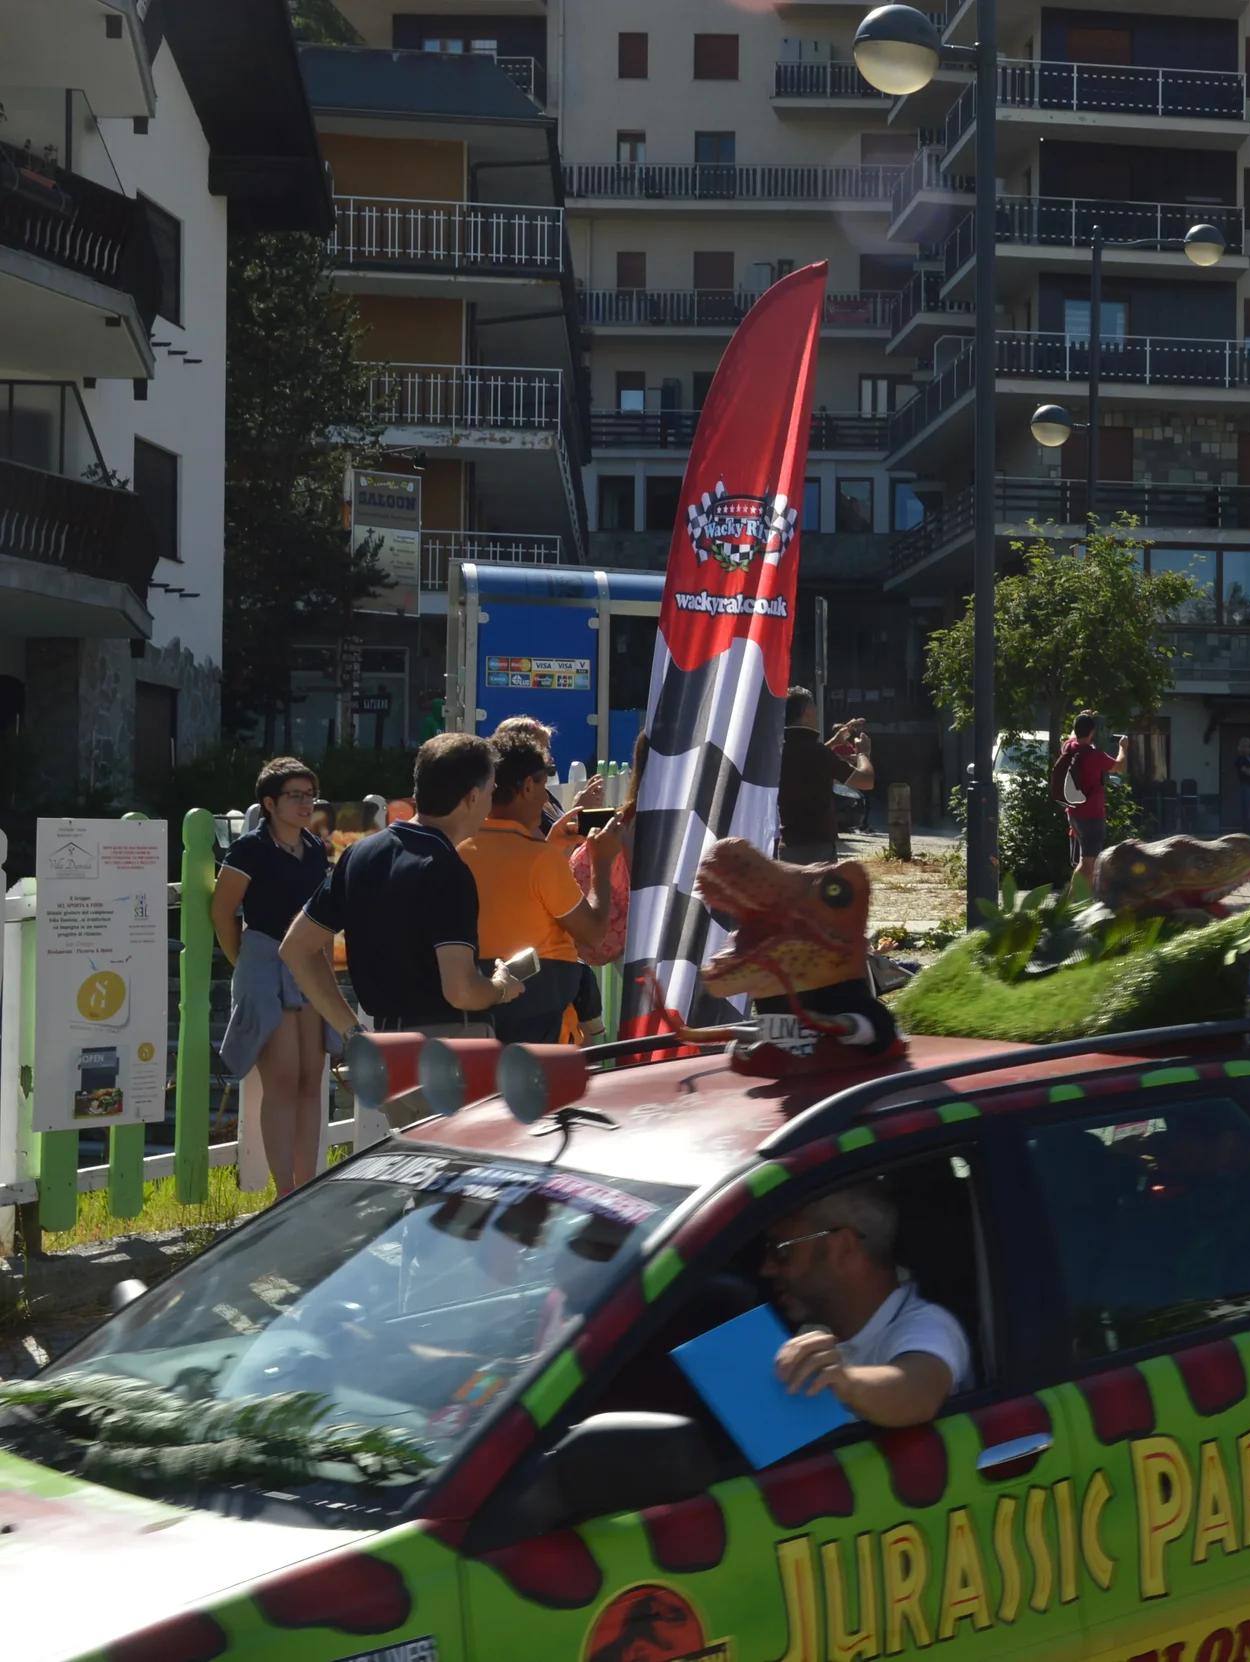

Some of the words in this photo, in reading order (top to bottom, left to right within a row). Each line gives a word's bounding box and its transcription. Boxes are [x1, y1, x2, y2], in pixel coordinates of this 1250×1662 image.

[704, 520, 744, 541] Wacky
[82, 1054, 104, 1063] OPEN
[775, 1467, 1118, 1662] JURASSIC
